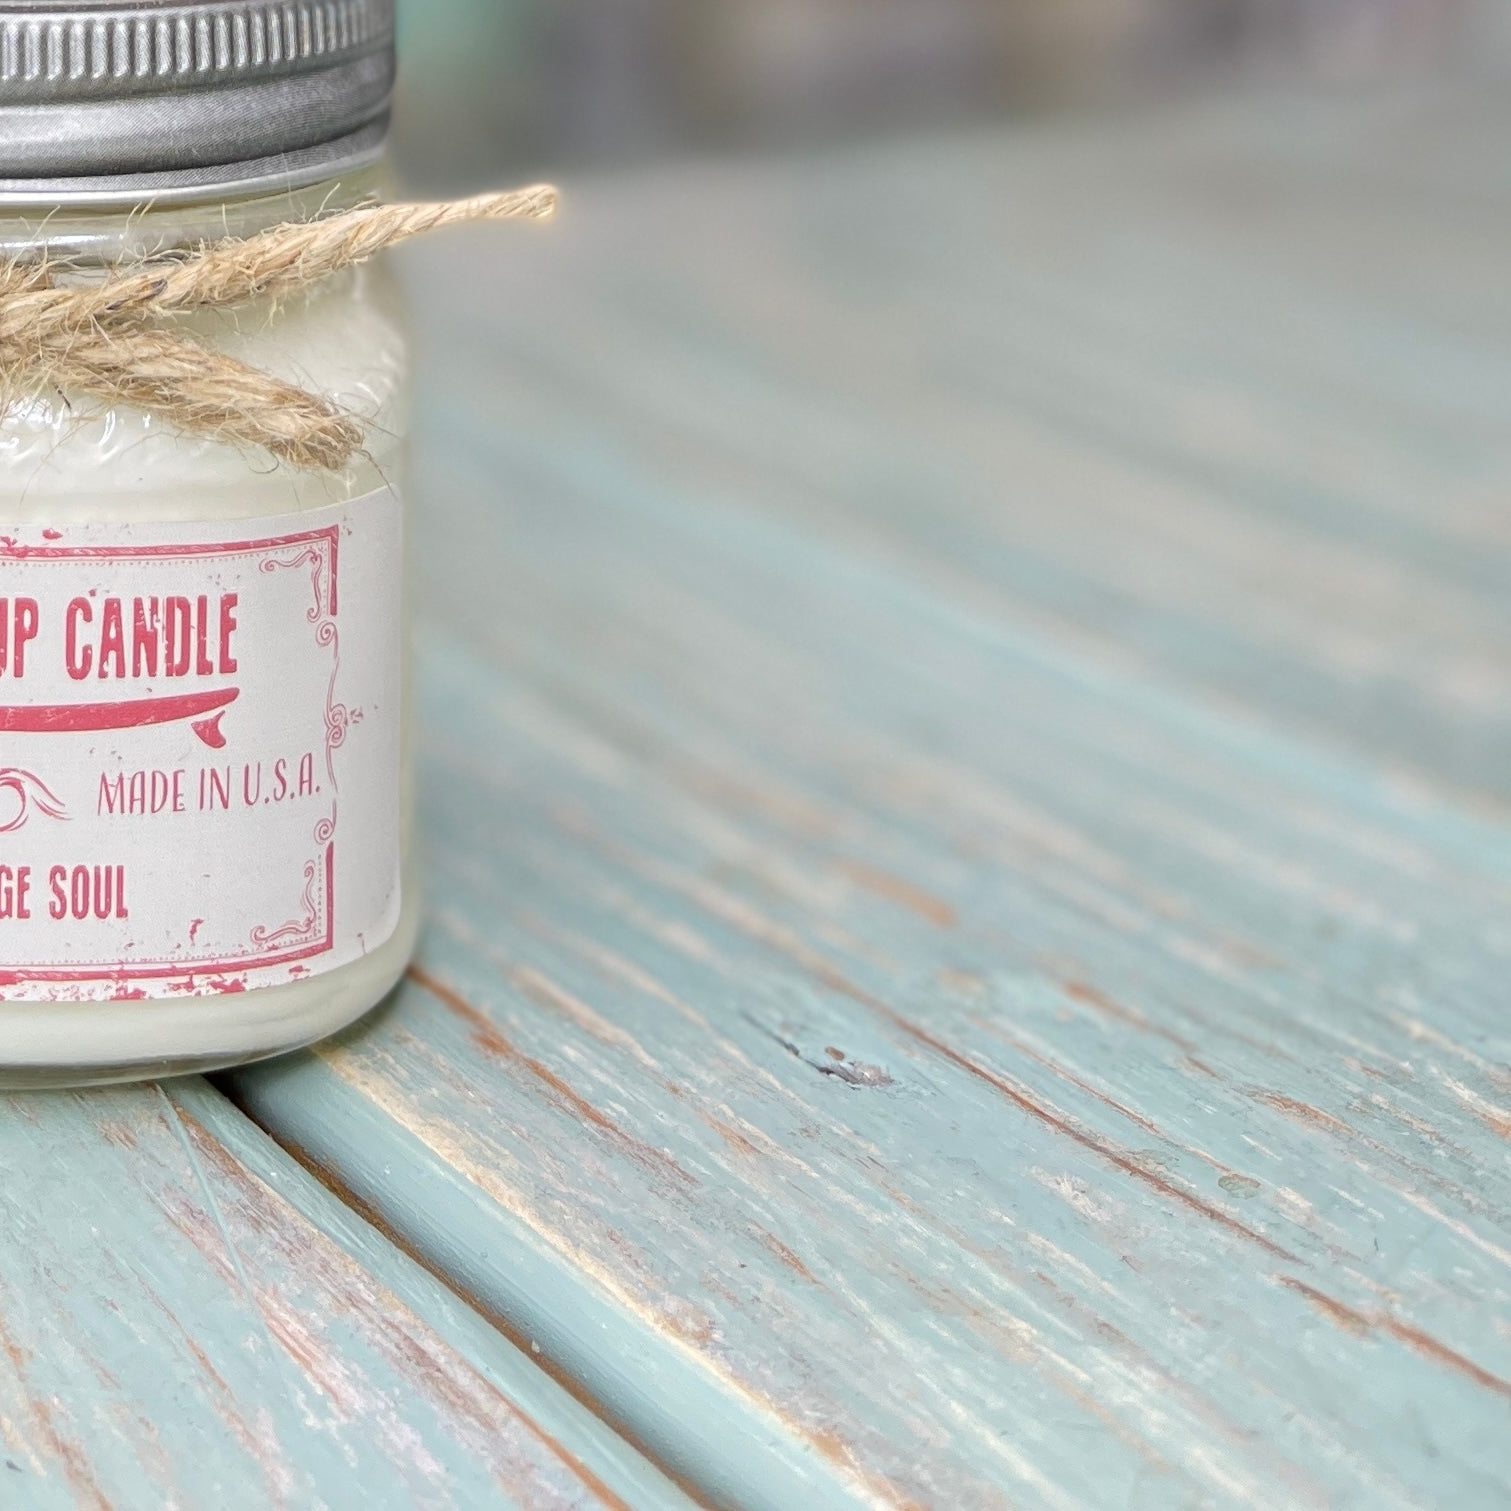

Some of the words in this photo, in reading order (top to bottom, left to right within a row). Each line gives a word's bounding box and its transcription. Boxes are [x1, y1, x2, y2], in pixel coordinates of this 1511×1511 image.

[64, 593, 239, 681] CANDLE
[97, 769, 186, 816] MADE
[199, 765, 231, 811] IN
[244, 751, 322, 807] U.S.A.
[48, 865, 130, 921] SOUL
